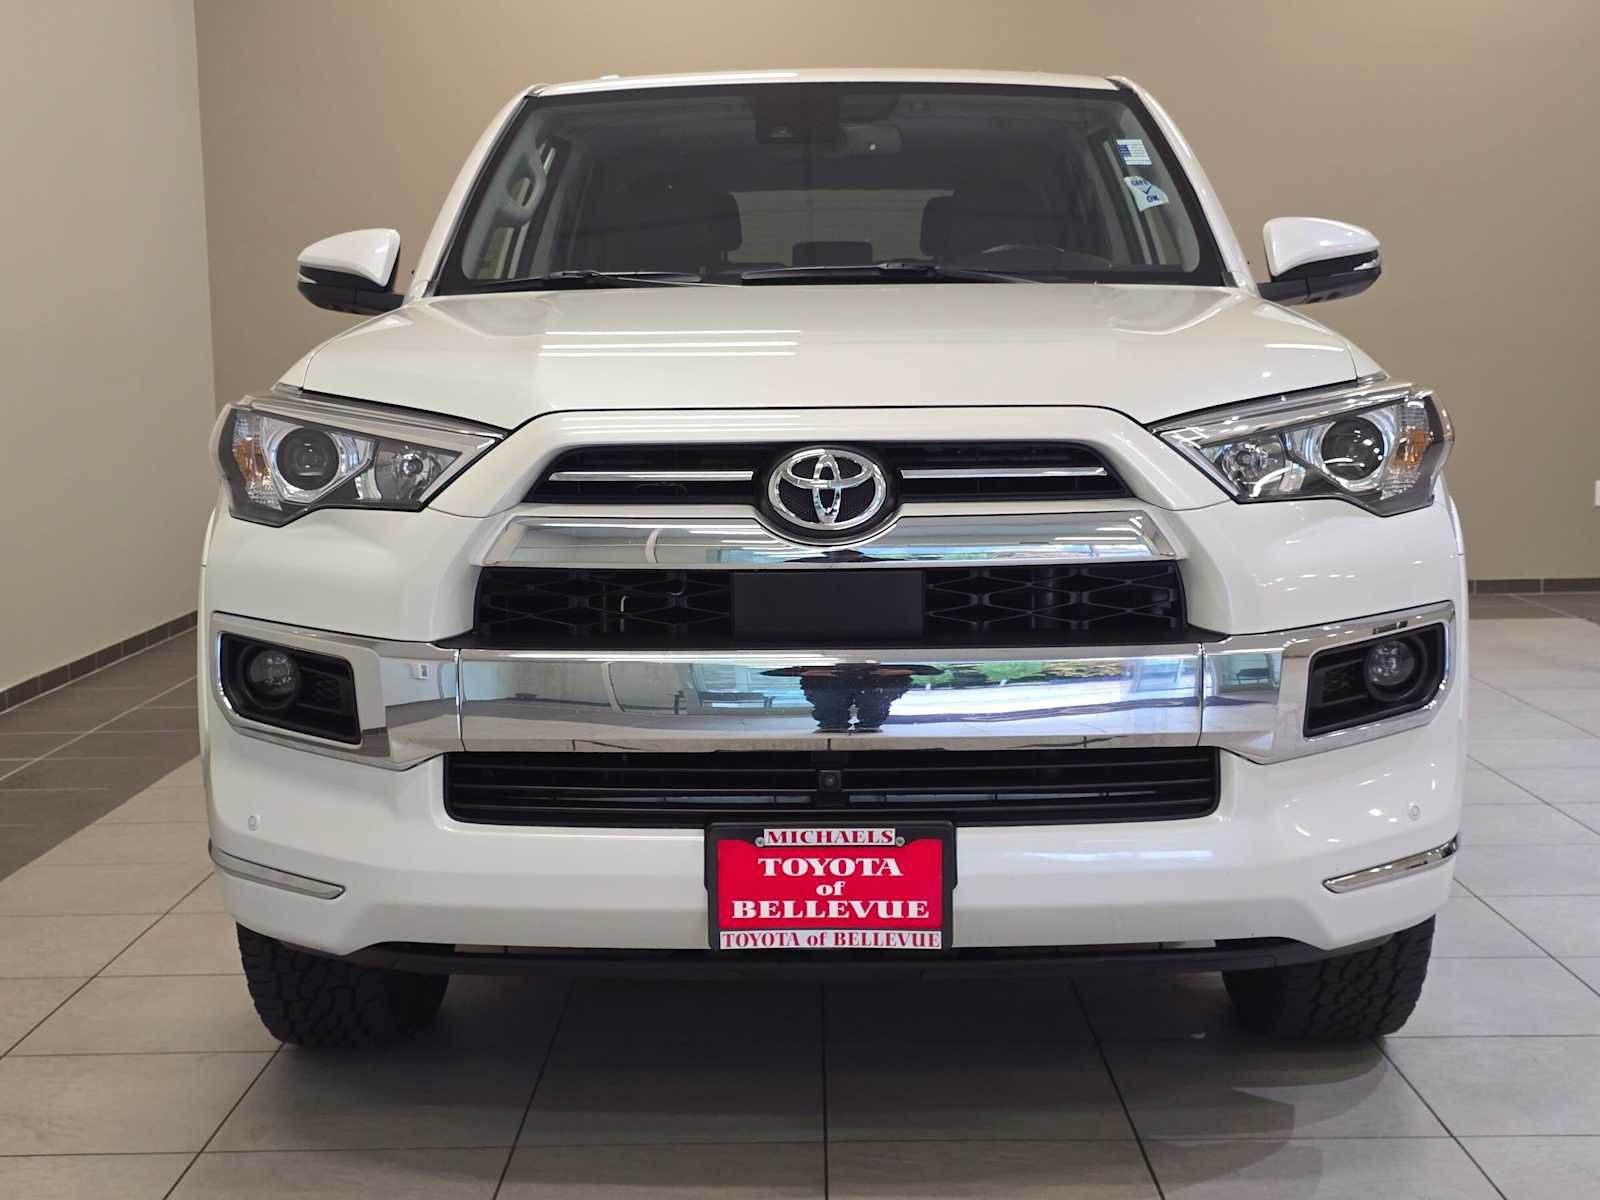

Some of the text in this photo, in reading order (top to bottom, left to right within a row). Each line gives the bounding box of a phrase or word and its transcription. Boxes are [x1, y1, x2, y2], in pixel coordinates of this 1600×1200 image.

[767, 830, 894, 844] MICHAELS
[757, 858, 904, 877] TOYOTA
[815, 880, 846, 896] of
[731, 900, 930, 919] BELLEVUE
[722, 931, 940, 948] TOYOTA of BELLEVUE
